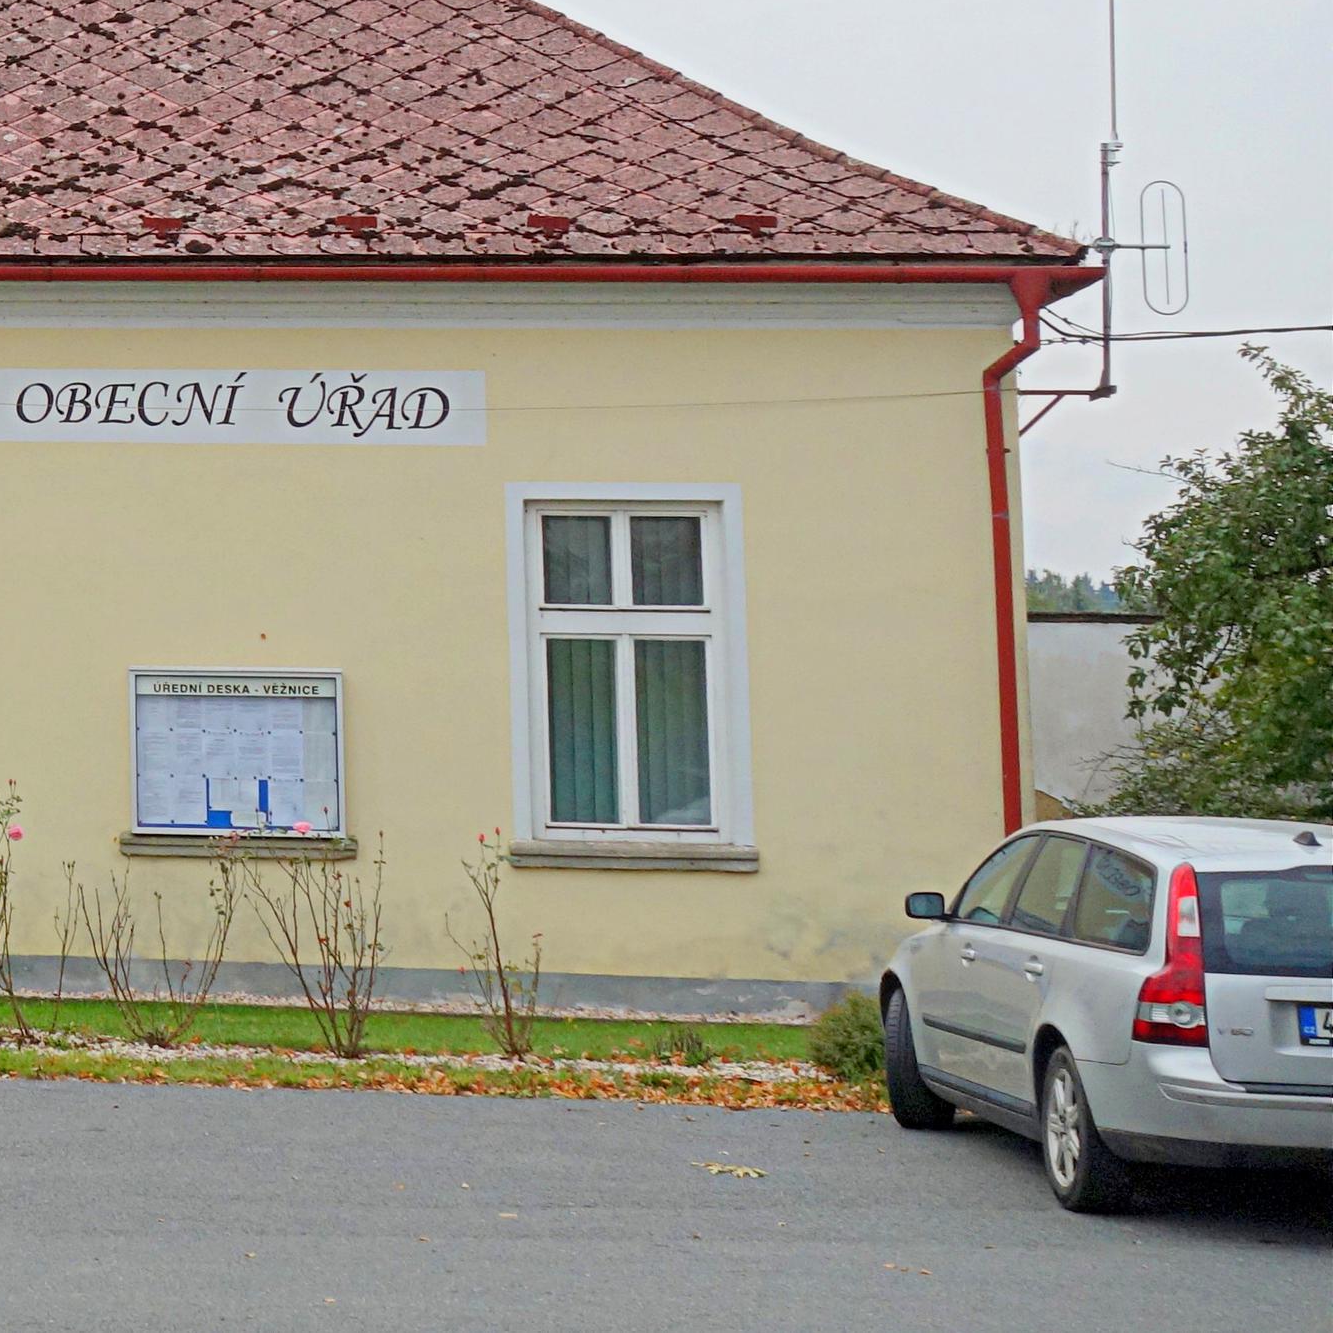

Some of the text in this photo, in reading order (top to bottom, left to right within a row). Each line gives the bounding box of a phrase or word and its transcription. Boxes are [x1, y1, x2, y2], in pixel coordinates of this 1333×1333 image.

[15, 371, 451, 438] OBECNÍ ÚŘAD
[153, 681, 202, 694] ÚŘEDNÍ
[207, 684, 250, 694] DESKA
[263, 682, 320, 695] VĚŽNICE
